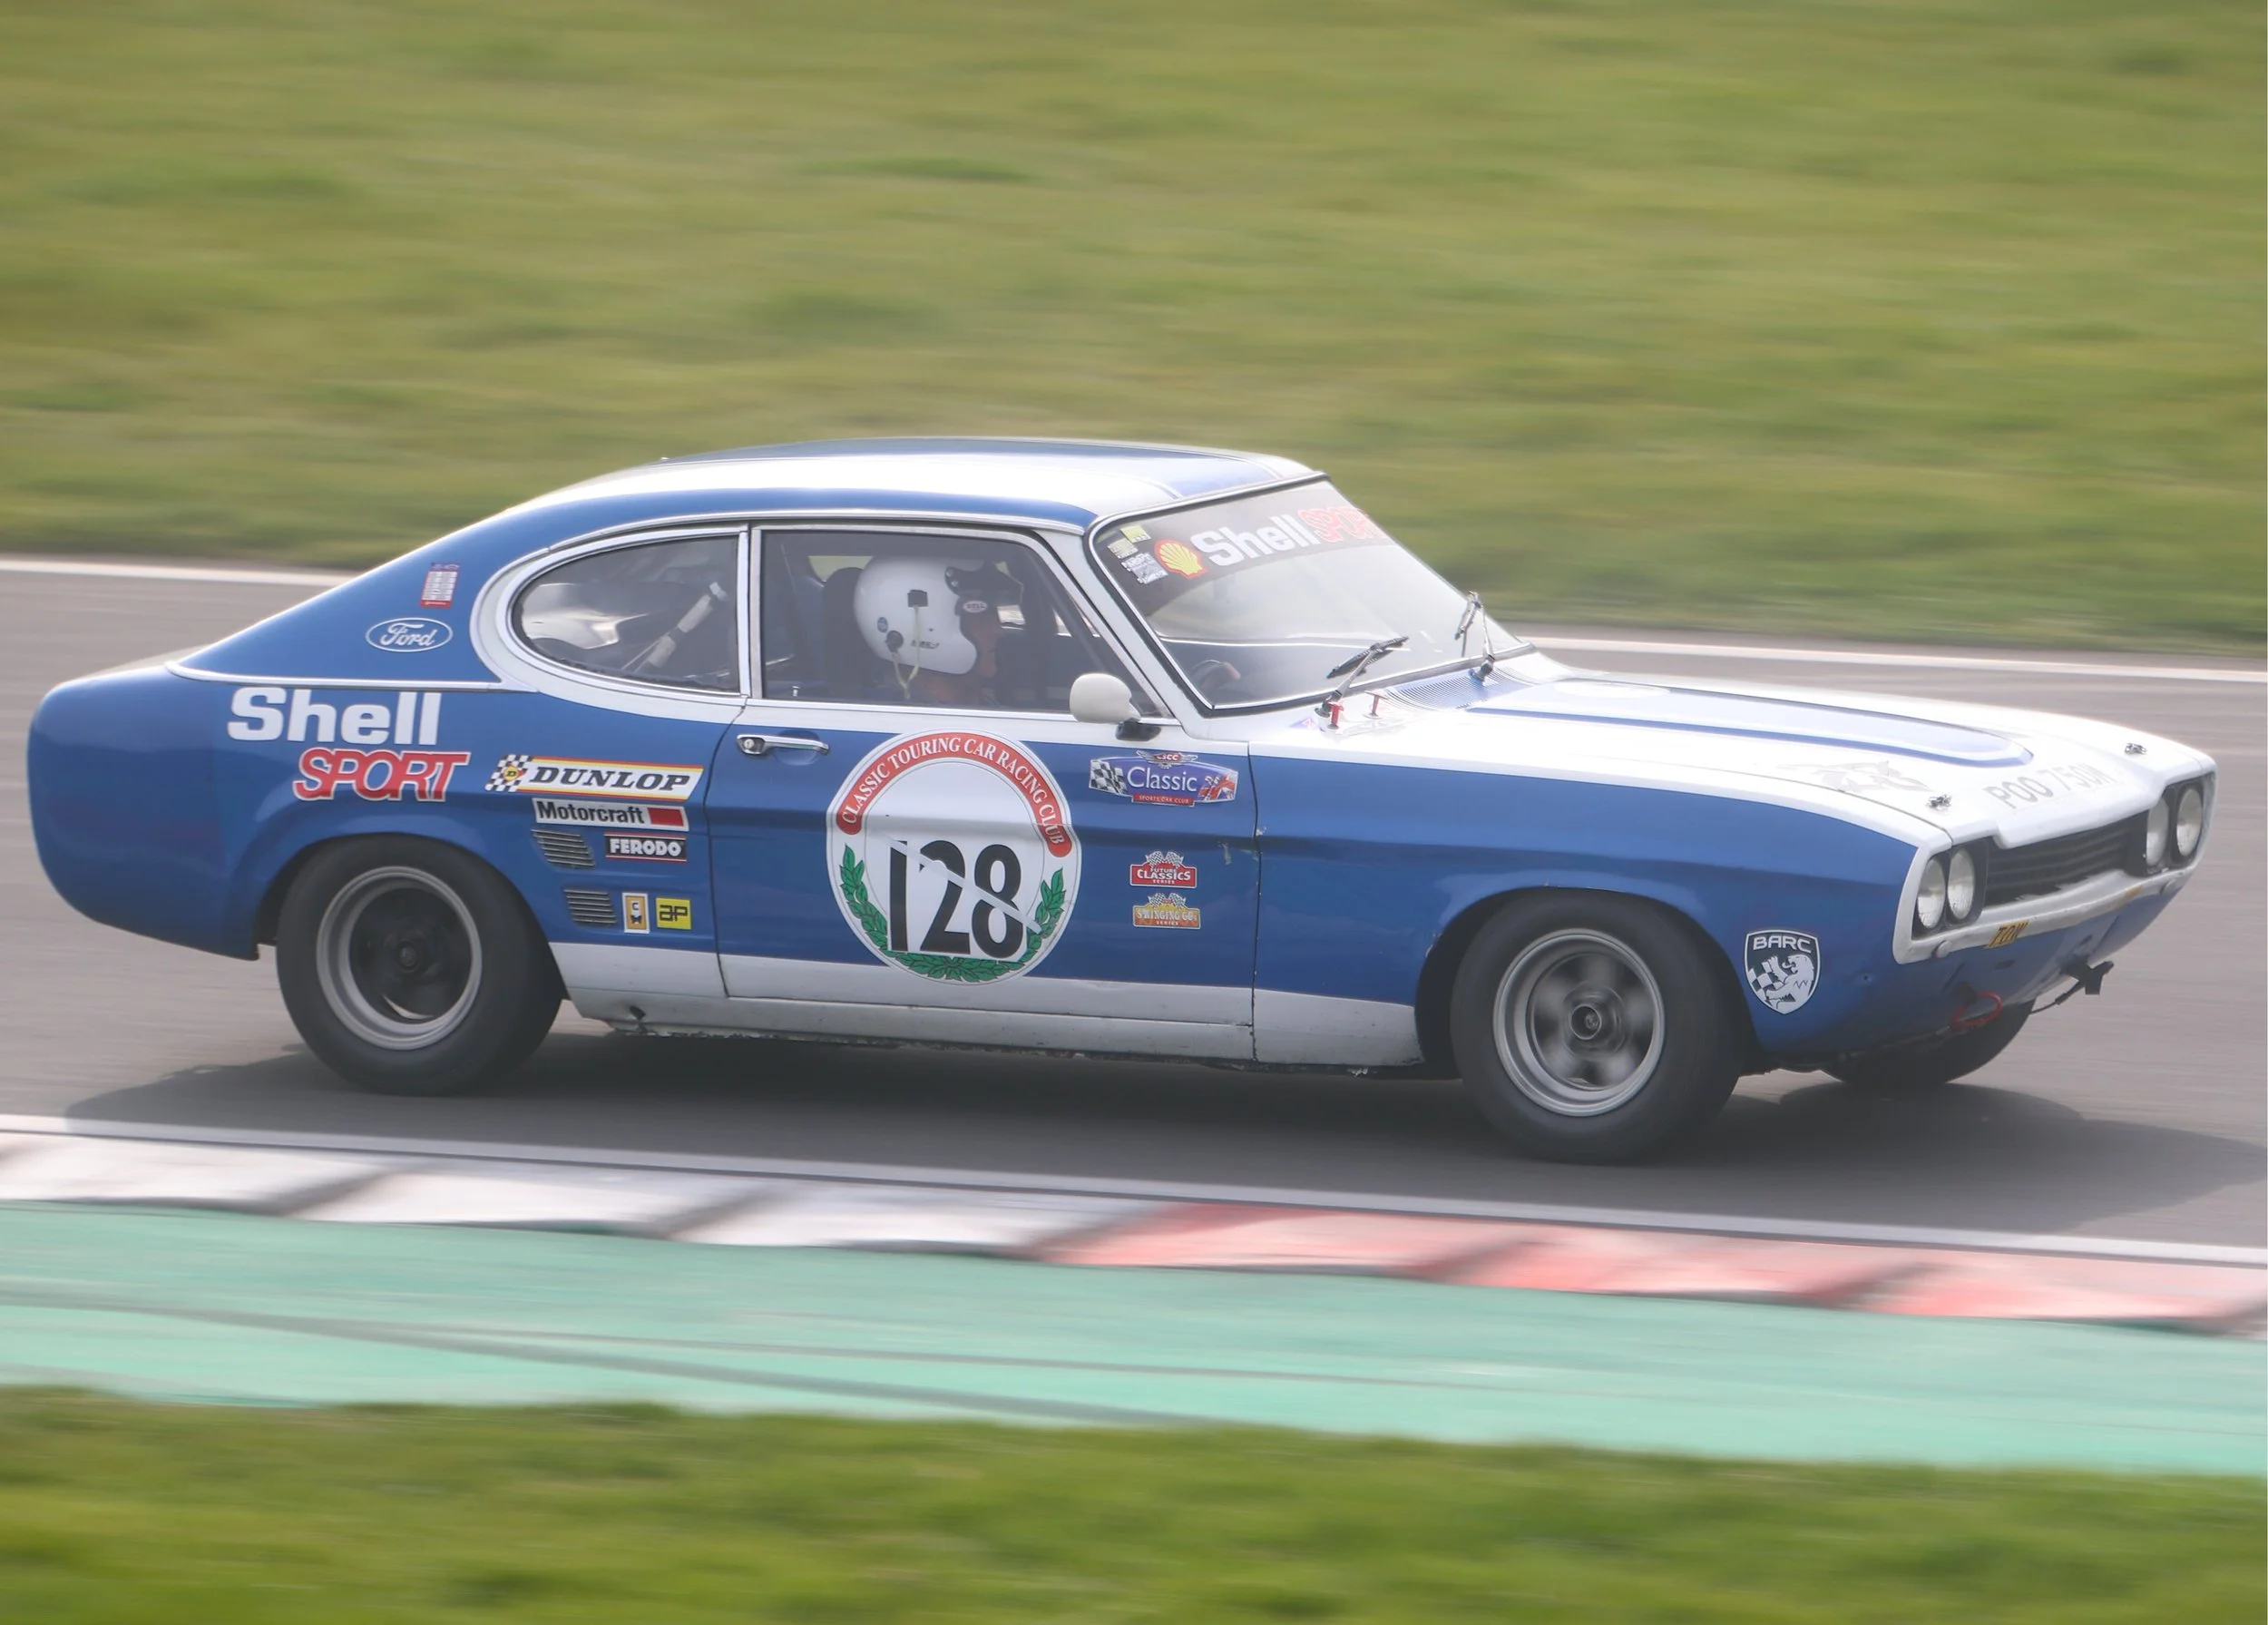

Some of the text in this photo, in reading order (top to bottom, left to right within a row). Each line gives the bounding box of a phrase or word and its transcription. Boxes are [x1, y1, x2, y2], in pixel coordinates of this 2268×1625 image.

[1190, 514, 1321, 566] Shell
[380, 622, 437, 646] Ford
[228, 687, 442, 745] Shell
[293, 748, 471, 802] SPORT
[530, 766, 690, 791] DUNLOP
[1127, 767, 1197, 791] Classic
[842, 737, 1065, 844] CLASSIC TOURING CAR RACING CLUB
[537, 800, 645, 825] Motorcraft
[610, 838, 682, 857] FERODO
[1137, 869, 1190, 880] CLASSICS
[890, 839, 1024, 959] 128
[1753, 935, 1812, 954] BARC
